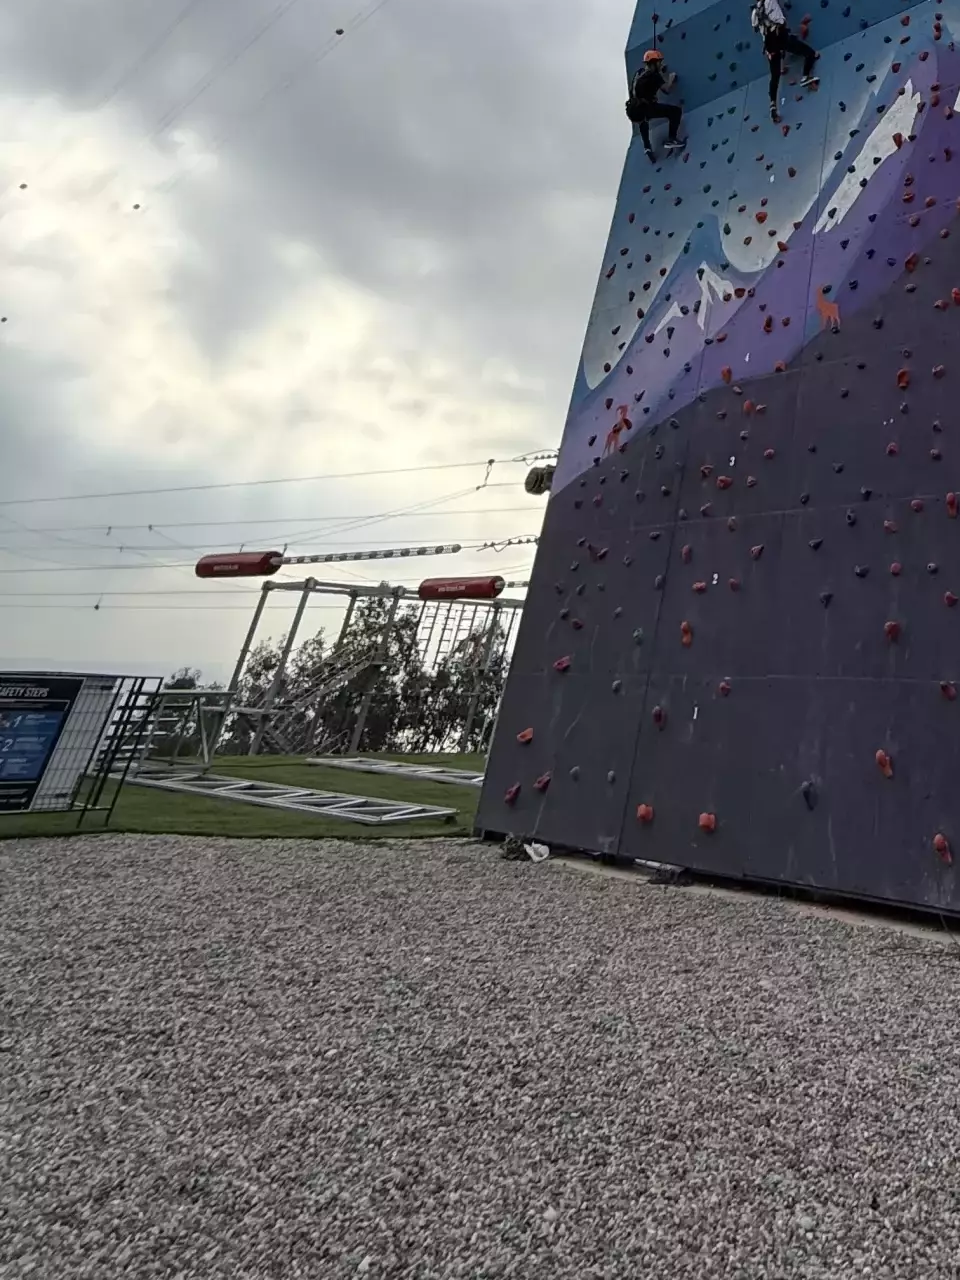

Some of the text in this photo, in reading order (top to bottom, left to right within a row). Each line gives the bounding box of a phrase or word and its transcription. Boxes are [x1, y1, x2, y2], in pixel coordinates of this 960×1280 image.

[712, 573, 719, 585] 2
[24, 687, 50, 697] STEPS
[2, 738, 13, 752] 2
